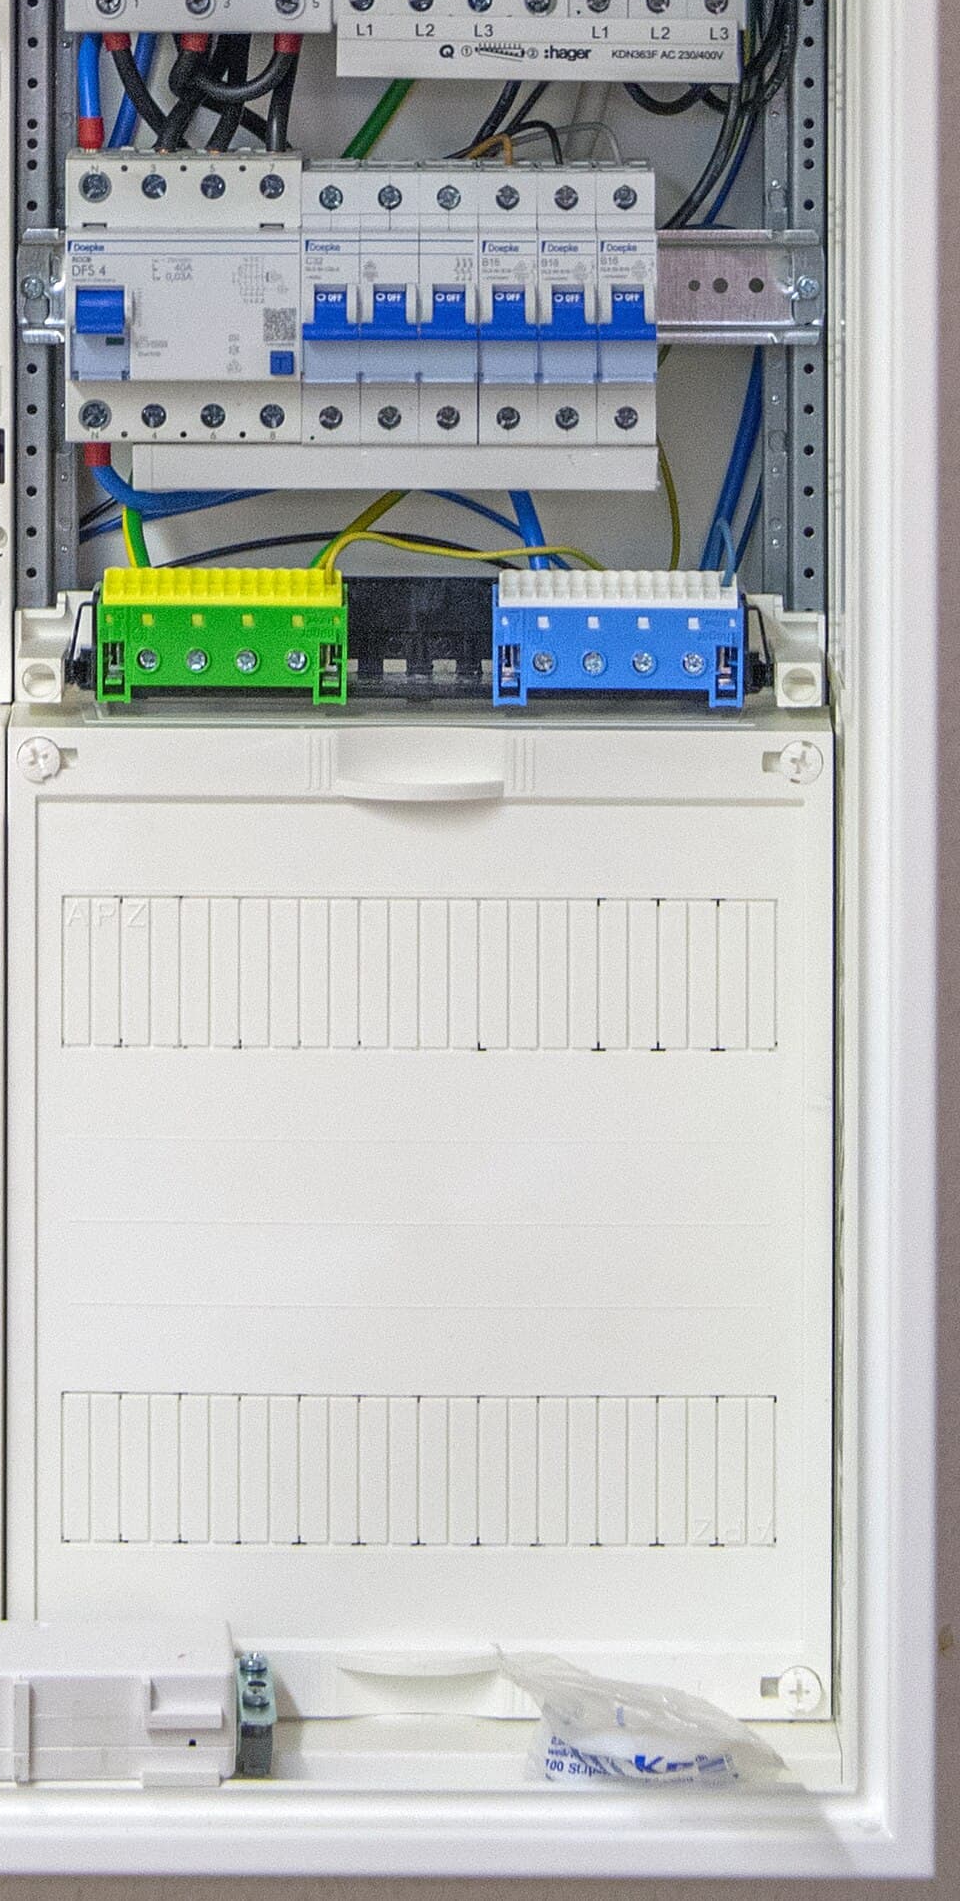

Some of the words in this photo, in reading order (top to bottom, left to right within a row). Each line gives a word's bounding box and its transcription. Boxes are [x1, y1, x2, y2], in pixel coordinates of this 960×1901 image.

[356, 24, 374, 37] L1
[416, 24, 435, 37] L2
[474, 24, 494, 37] L3
[592, 25, 608, 39] L1
[650, 25, 670, 39] L2
[710, 27, 728, 40] L3
[660, 50, 676, 60] AC
[678, 50, 724, 60] 230/400V
[74, 243, 104, 251] Doepke
[72, 265, 96, 277] DFS
[99, 265, 106, 277] 4
[328, 293, 342, 302] OFF
[387, 293, 402, 302] OFF
[506, 293, 520, 302] OFF
[624, 294, 640, 303] OFF
